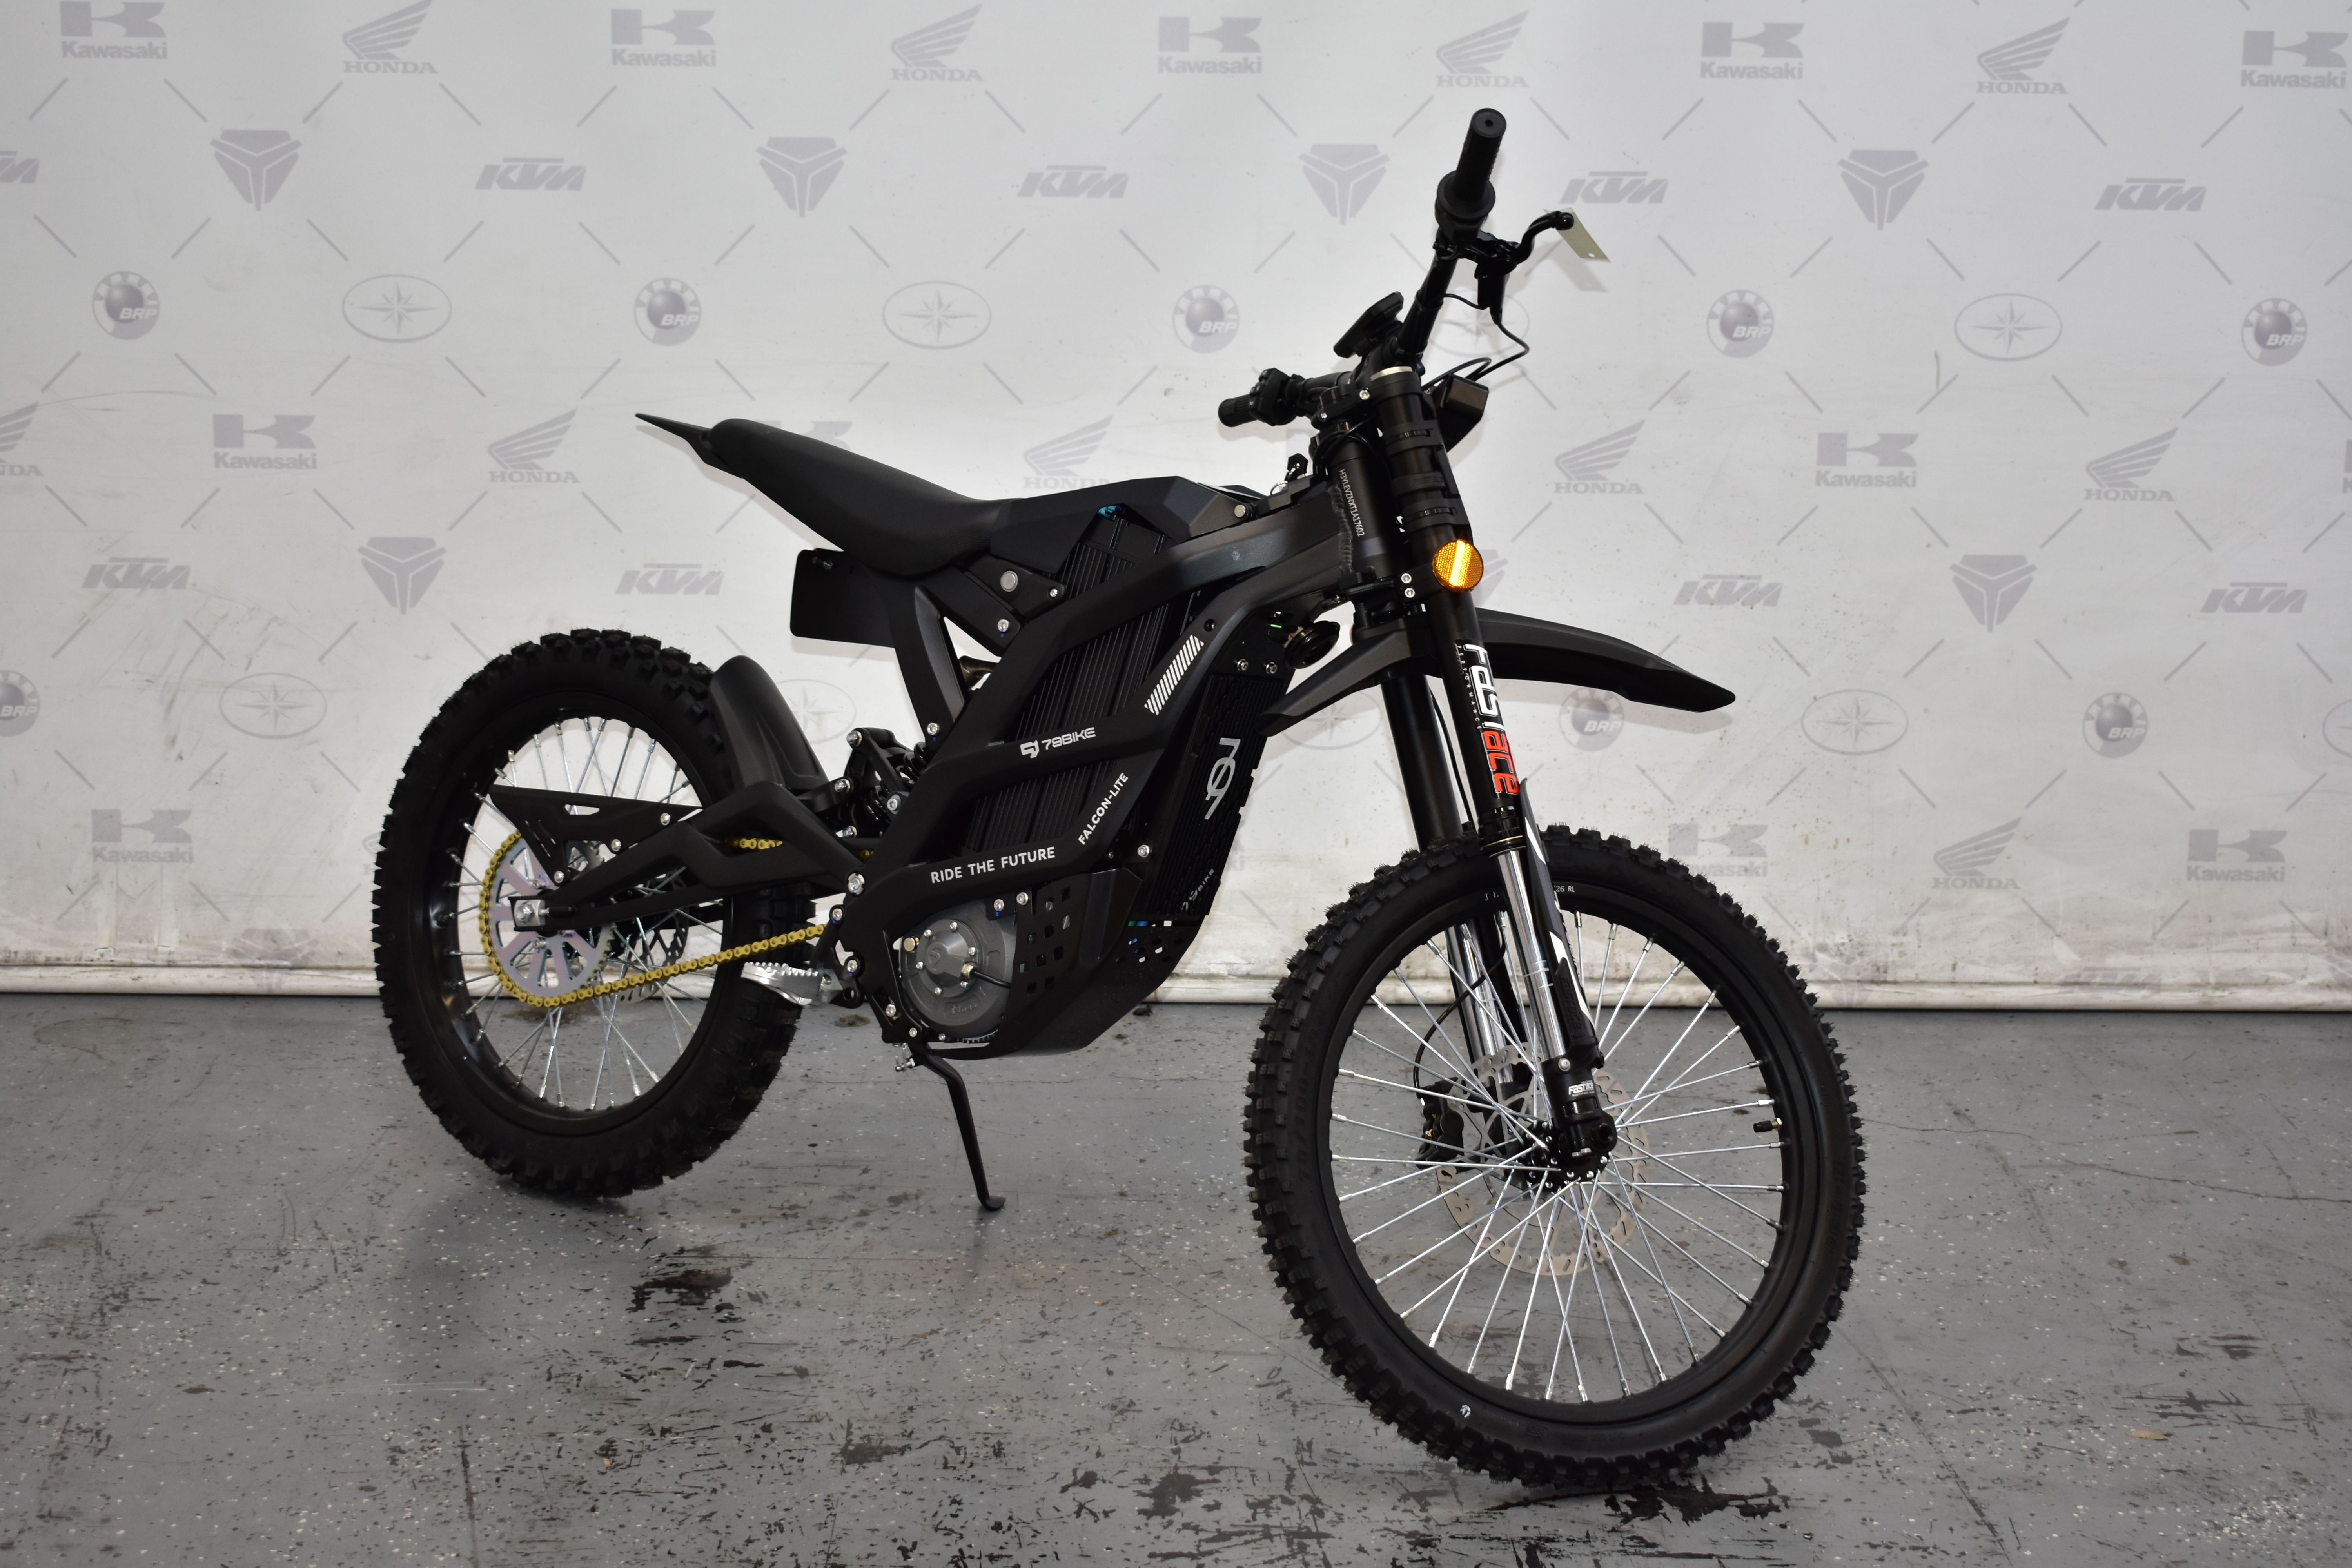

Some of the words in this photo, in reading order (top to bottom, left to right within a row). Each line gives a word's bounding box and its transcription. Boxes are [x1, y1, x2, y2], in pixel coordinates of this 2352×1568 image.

[62, 41, 167, 60] Kawasaki
[611, 48, 716, 67] Kawasaki
[343, 60, 439, 74] HONDA
[1158, 56, 1262, 74] Kawasaki
[1700, 60, 1804, 80] Kawasaki
[891, 68, 984, 82] HONDA
[1436, 74, 1528, 88] HONDA
[2241, 69, 2346, 89] Kawasaki
[1976, 80, 2069, 94] HONDA
[474, 158, 586, 190] KTM
[1017, 165, 1129, 198] KTM
[1559, 172, 1668, 203] KTM
[2094, 178, 2207, 211] KTM
[119, 308, 157, 319] BRP
[661, 314, 699, 326] BRP
[1198, 321, 1236, 334] BRP
[1733, 326, 1770, 338] BRP
[2266, 334, 2303, 346] BRP
[214, 452, 317, 470] Kawasaki
[489, 471, 580, 483] HONDA
[1815, 471, 1916, 488] Kawasaki
[1554, 483, 1644, 494] HONDA
[2085, 489, 2174, 502] HONDA
[82, 558, 191, 589] KTM
[615, 564, 724, 594] KTM
[1673, 575, 1782, 606] KTM
[2201, 582, 2308, 613] KTM
[1457, 645, 1482, 730] PERFORMANCE
[2, 705, 38, 717] BRP
[1584, 720, 1622, 732] BRP
[2109, 727, 2145, 739] BRP
[1042, 727, 1096, 750] 79BIKE
[1078, 773, 1129, 845] FALCON-LITE
[92, 847, 194, 864] Kawasaki
[931, 866, 962, 883] RIDE
[967, 859, 995, 875] THE
[1001, 846, 1055, 868] FUTURE
[2187, 866, 2285, 882] Kawasaki
[1932, 878, 2020, 890] HONDA
